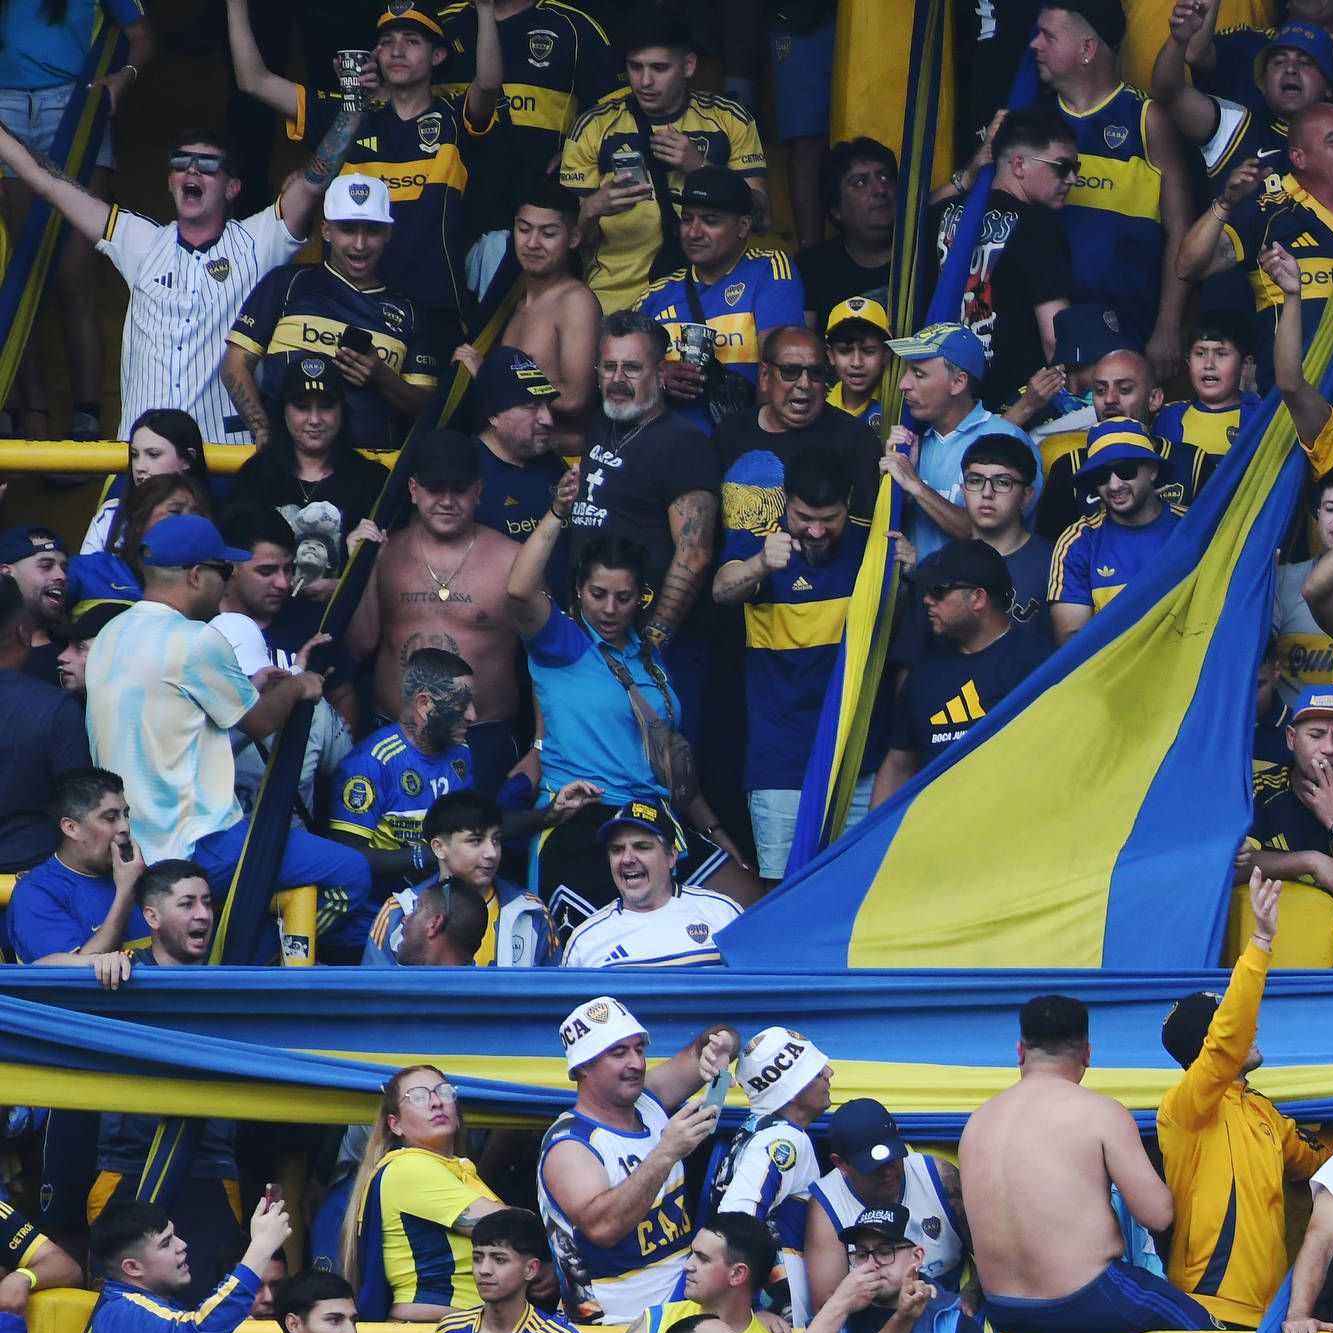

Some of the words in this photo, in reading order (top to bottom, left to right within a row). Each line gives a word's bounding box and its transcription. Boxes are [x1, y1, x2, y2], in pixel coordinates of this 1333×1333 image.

[382, 174, 427, 190] tsso
[302, 321, 399, 367] beton
[1163, 490, 1181, 498] CABJ
[932, 731, 951, 743] BOCA
[749, 1042, 803, 1094] BOCA
